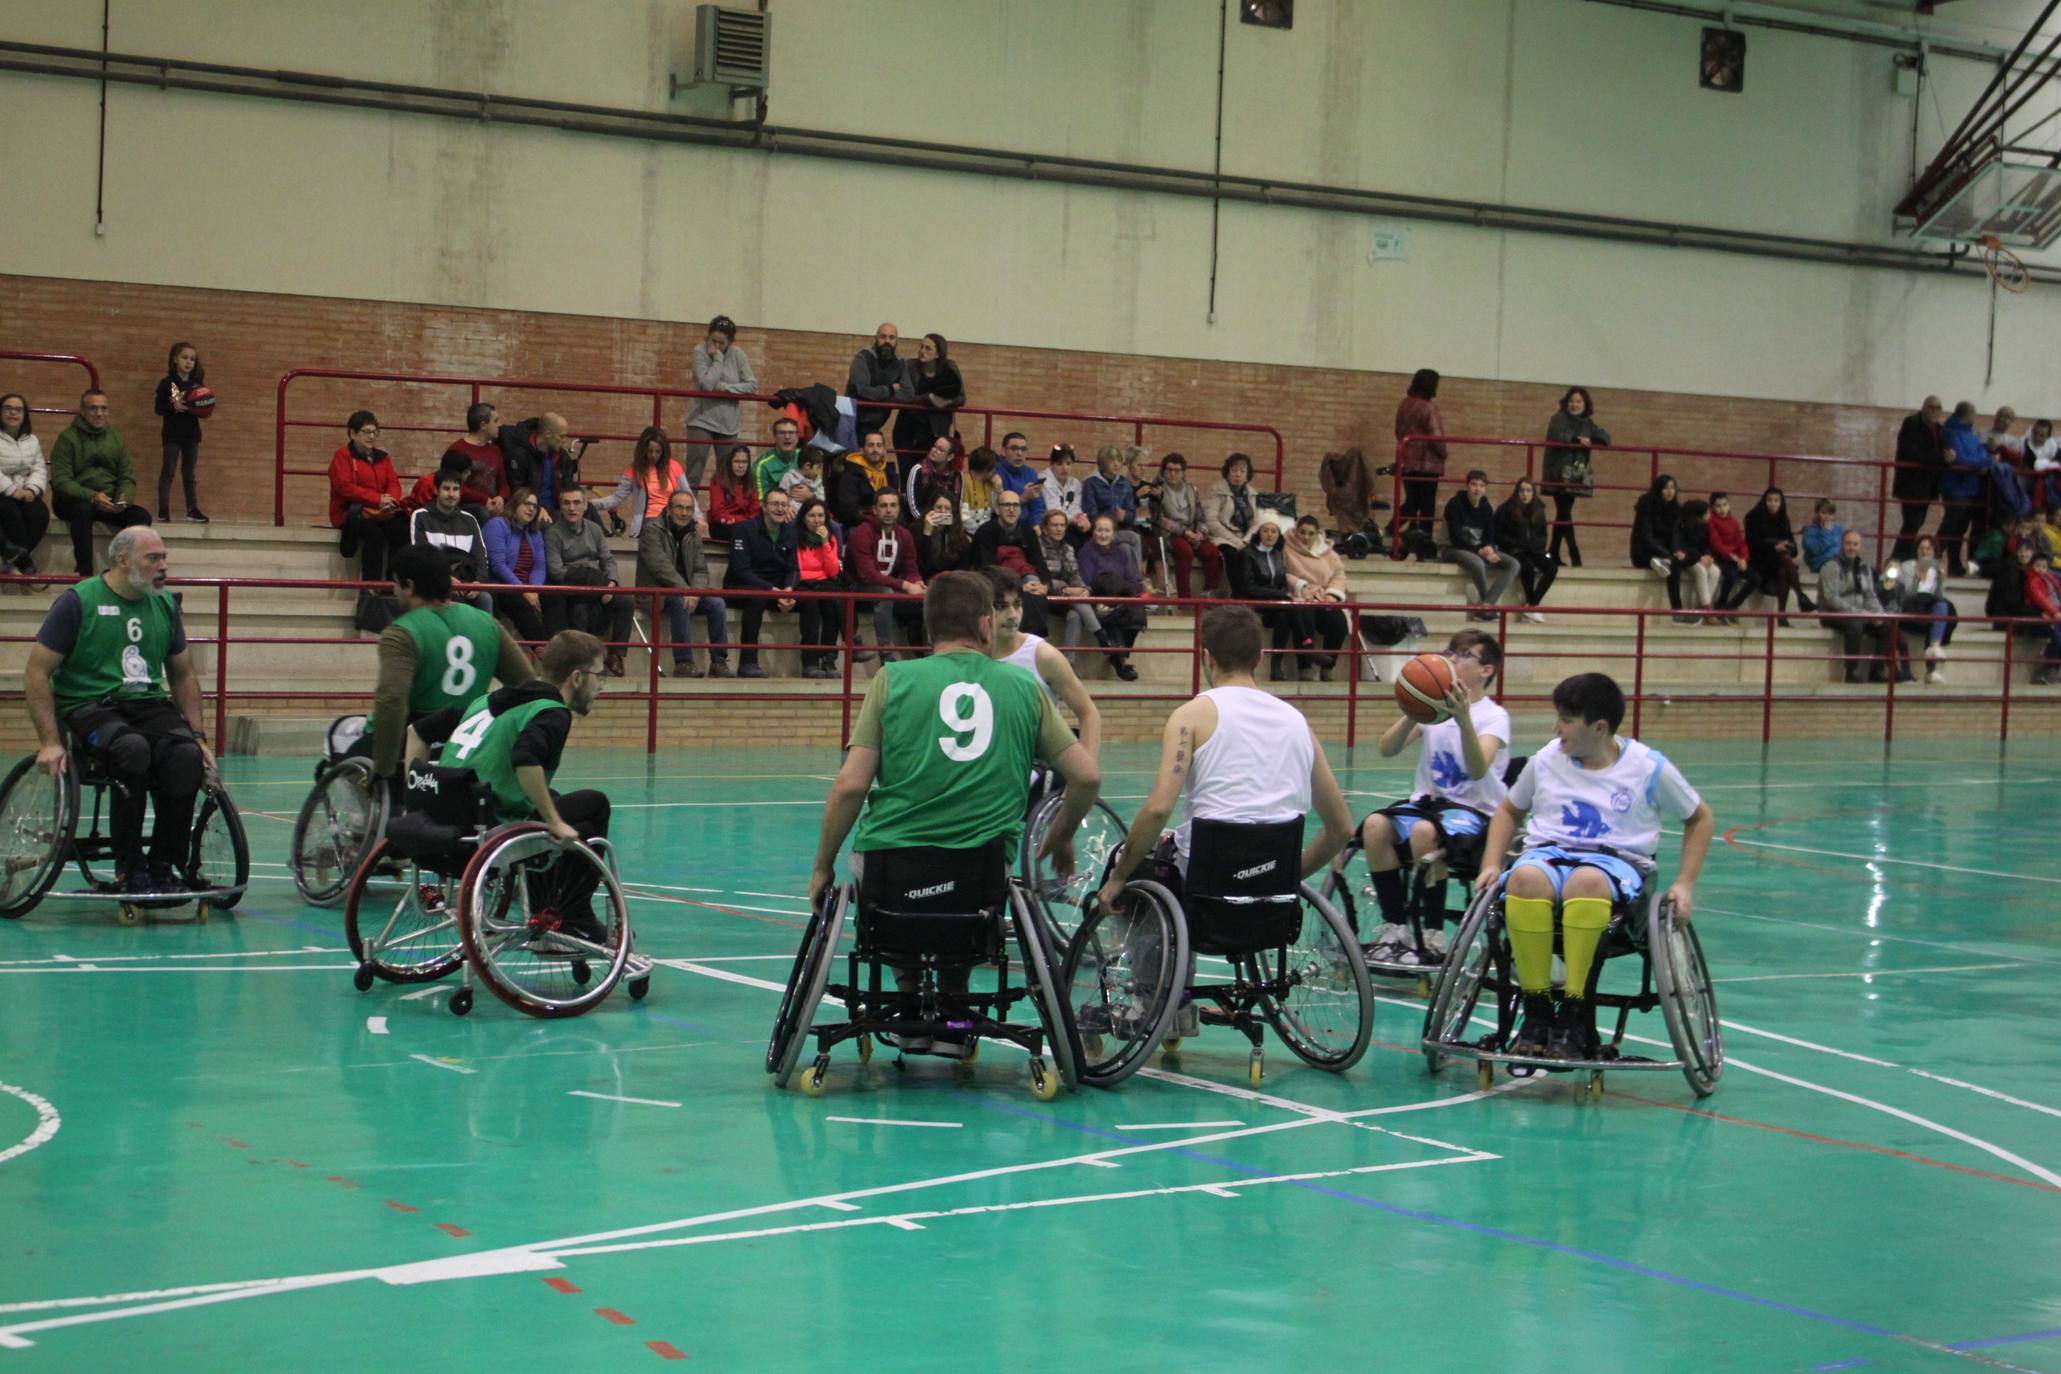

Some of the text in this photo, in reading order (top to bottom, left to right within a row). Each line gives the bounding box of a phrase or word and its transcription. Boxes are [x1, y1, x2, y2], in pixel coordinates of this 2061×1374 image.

[127, 617, 143, 642] 6
[442, 635, 477, 696] 8
[449, 709, 495, 760] 4
[938, 681, 994, 762] 9
[908, 880, 955, 900] QUICKIE
